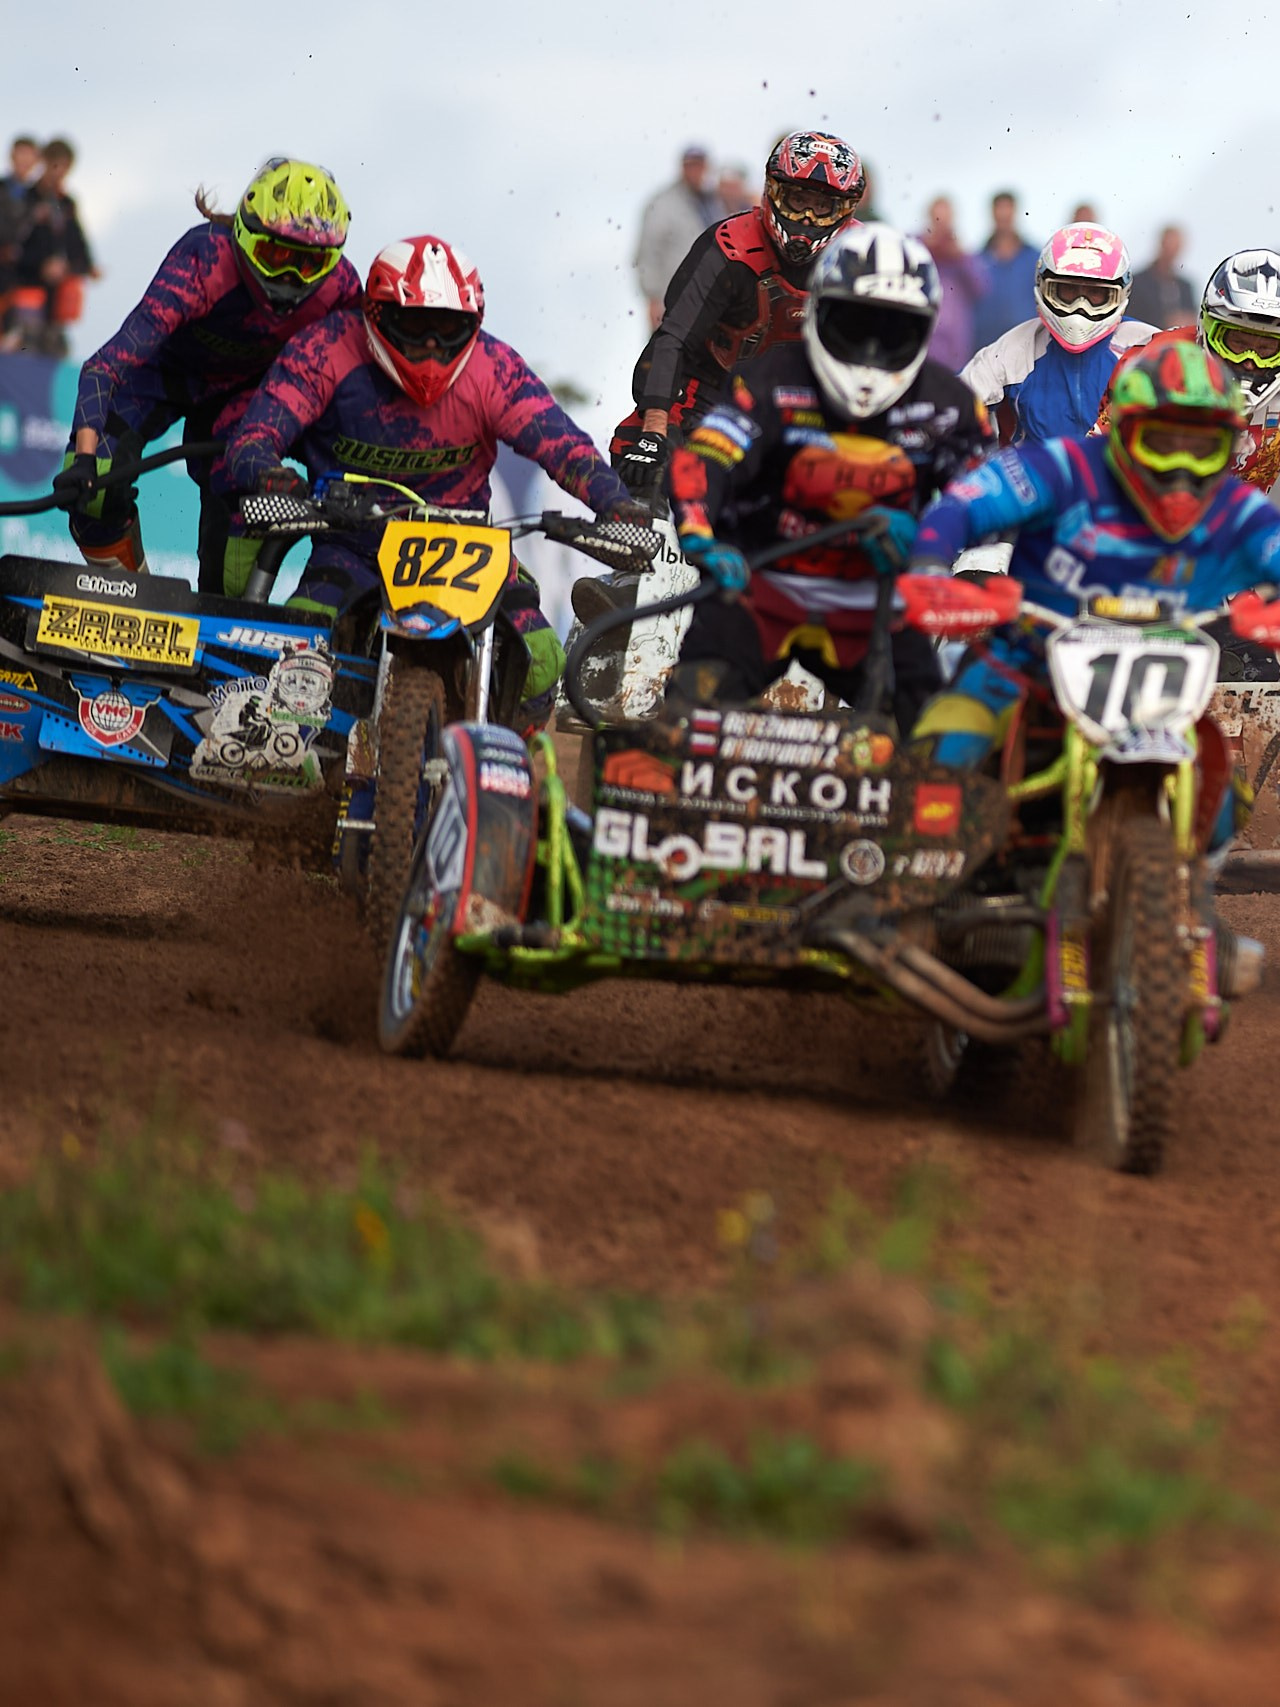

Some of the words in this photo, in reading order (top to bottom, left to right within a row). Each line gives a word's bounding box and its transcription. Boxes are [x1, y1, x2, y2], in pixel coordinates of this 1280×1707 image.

[813, 143, 834, 153] BELL
[853, 272, 929, 306] FOX
[624, 453, 657, 464] FOX
[392, 536, 493, 593] 822
[46, 602, 191, 656] ZABEL
[95, 702, 130, 718] VMC
[1083, 653, 1189, 724] 10
[680, 761, 892, 816] ИСКОН
[594, 807, 828, 882] GLOBAL
